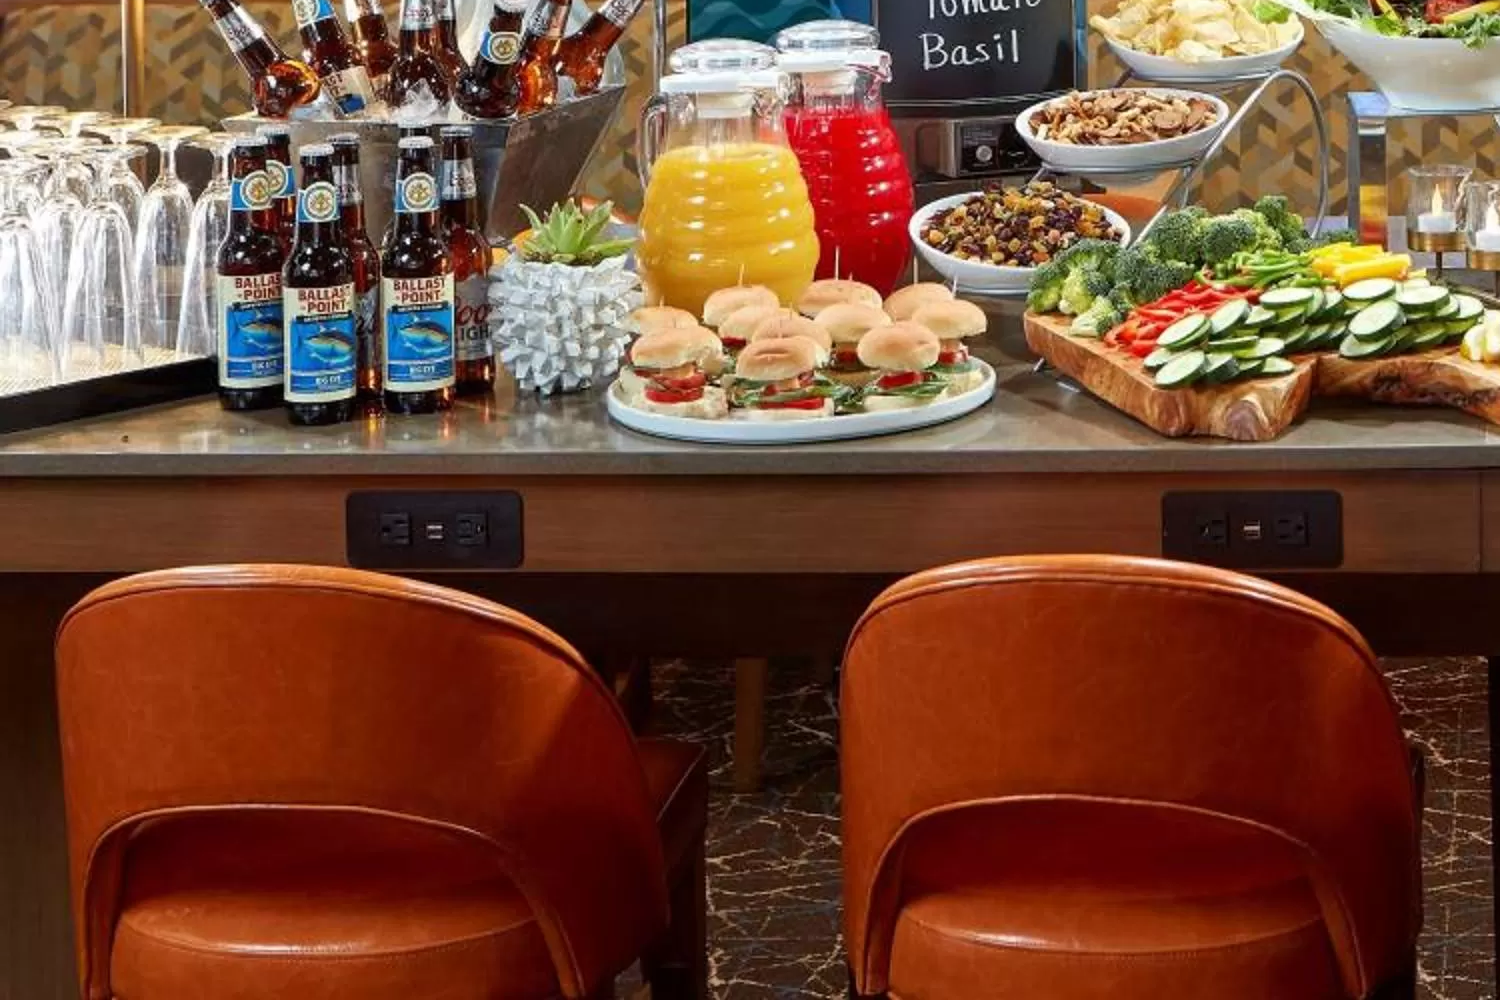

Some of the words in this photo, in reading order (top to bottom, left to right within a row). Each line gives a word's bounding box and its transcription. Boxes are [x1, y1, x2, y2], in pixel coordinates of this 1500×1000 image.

[918, 28, 1019, 71] Basil
[235, 272, 282, 289] BALLAS
[393, 276, 446, 291] BALLAST
[401, 289, 442, 304] POINT
[307, 299, 346, 313] POINT
